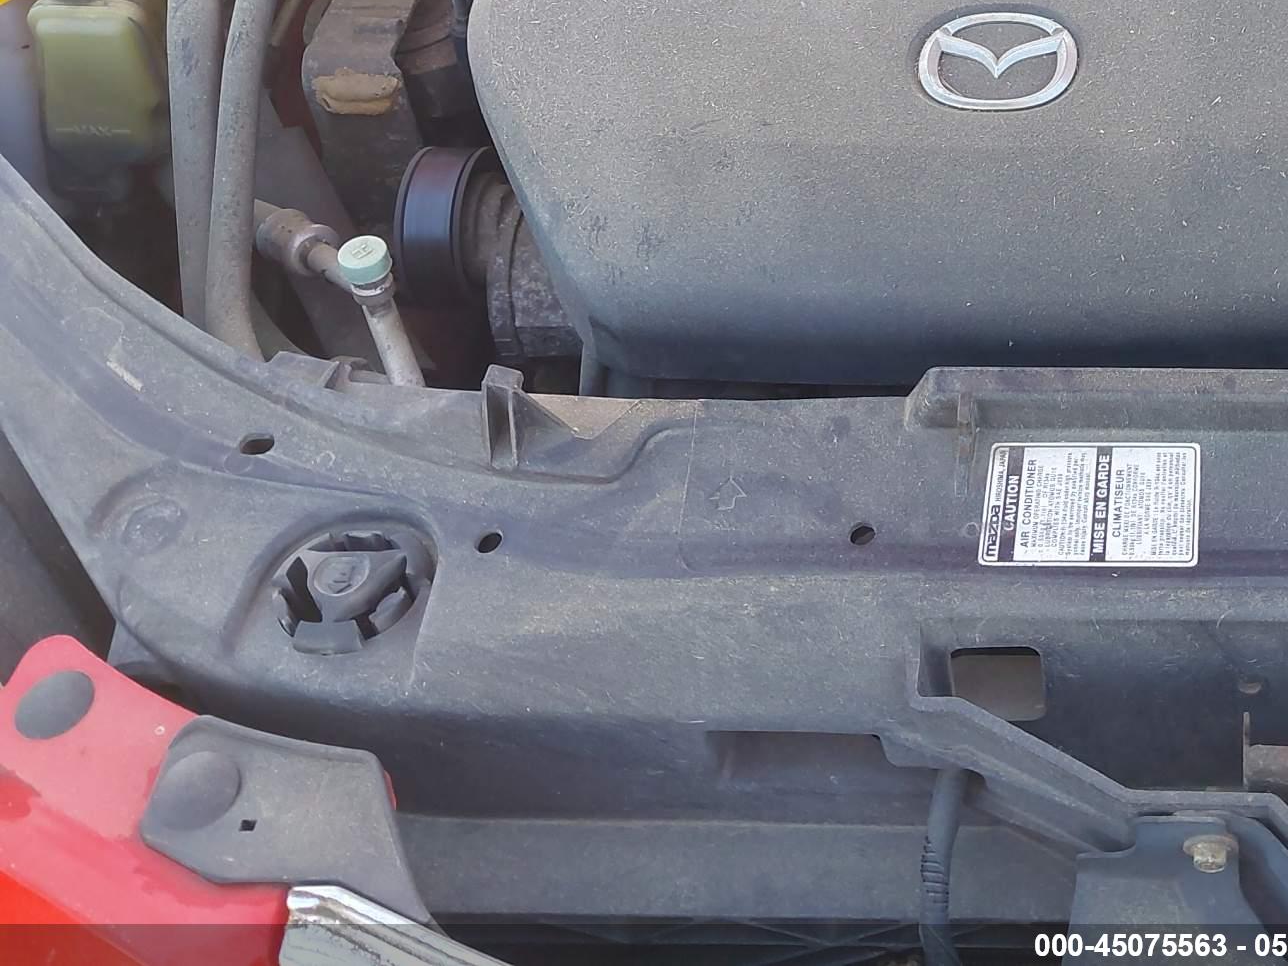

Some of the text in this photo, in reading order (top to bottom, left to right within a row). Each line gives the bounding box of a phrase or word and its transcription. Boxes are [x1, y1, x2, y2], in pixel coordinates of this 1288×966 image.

[986, 504, 1000, 555] mazda
[1004, 475, 1020, 530] CAUTION
[1020, 459, 1037, 548] AIR CONDITIONER
[1092, 454, 1111, 552] MISE EN GARDE
[1112, 468, 1124, 537] CLIMATISEUR
